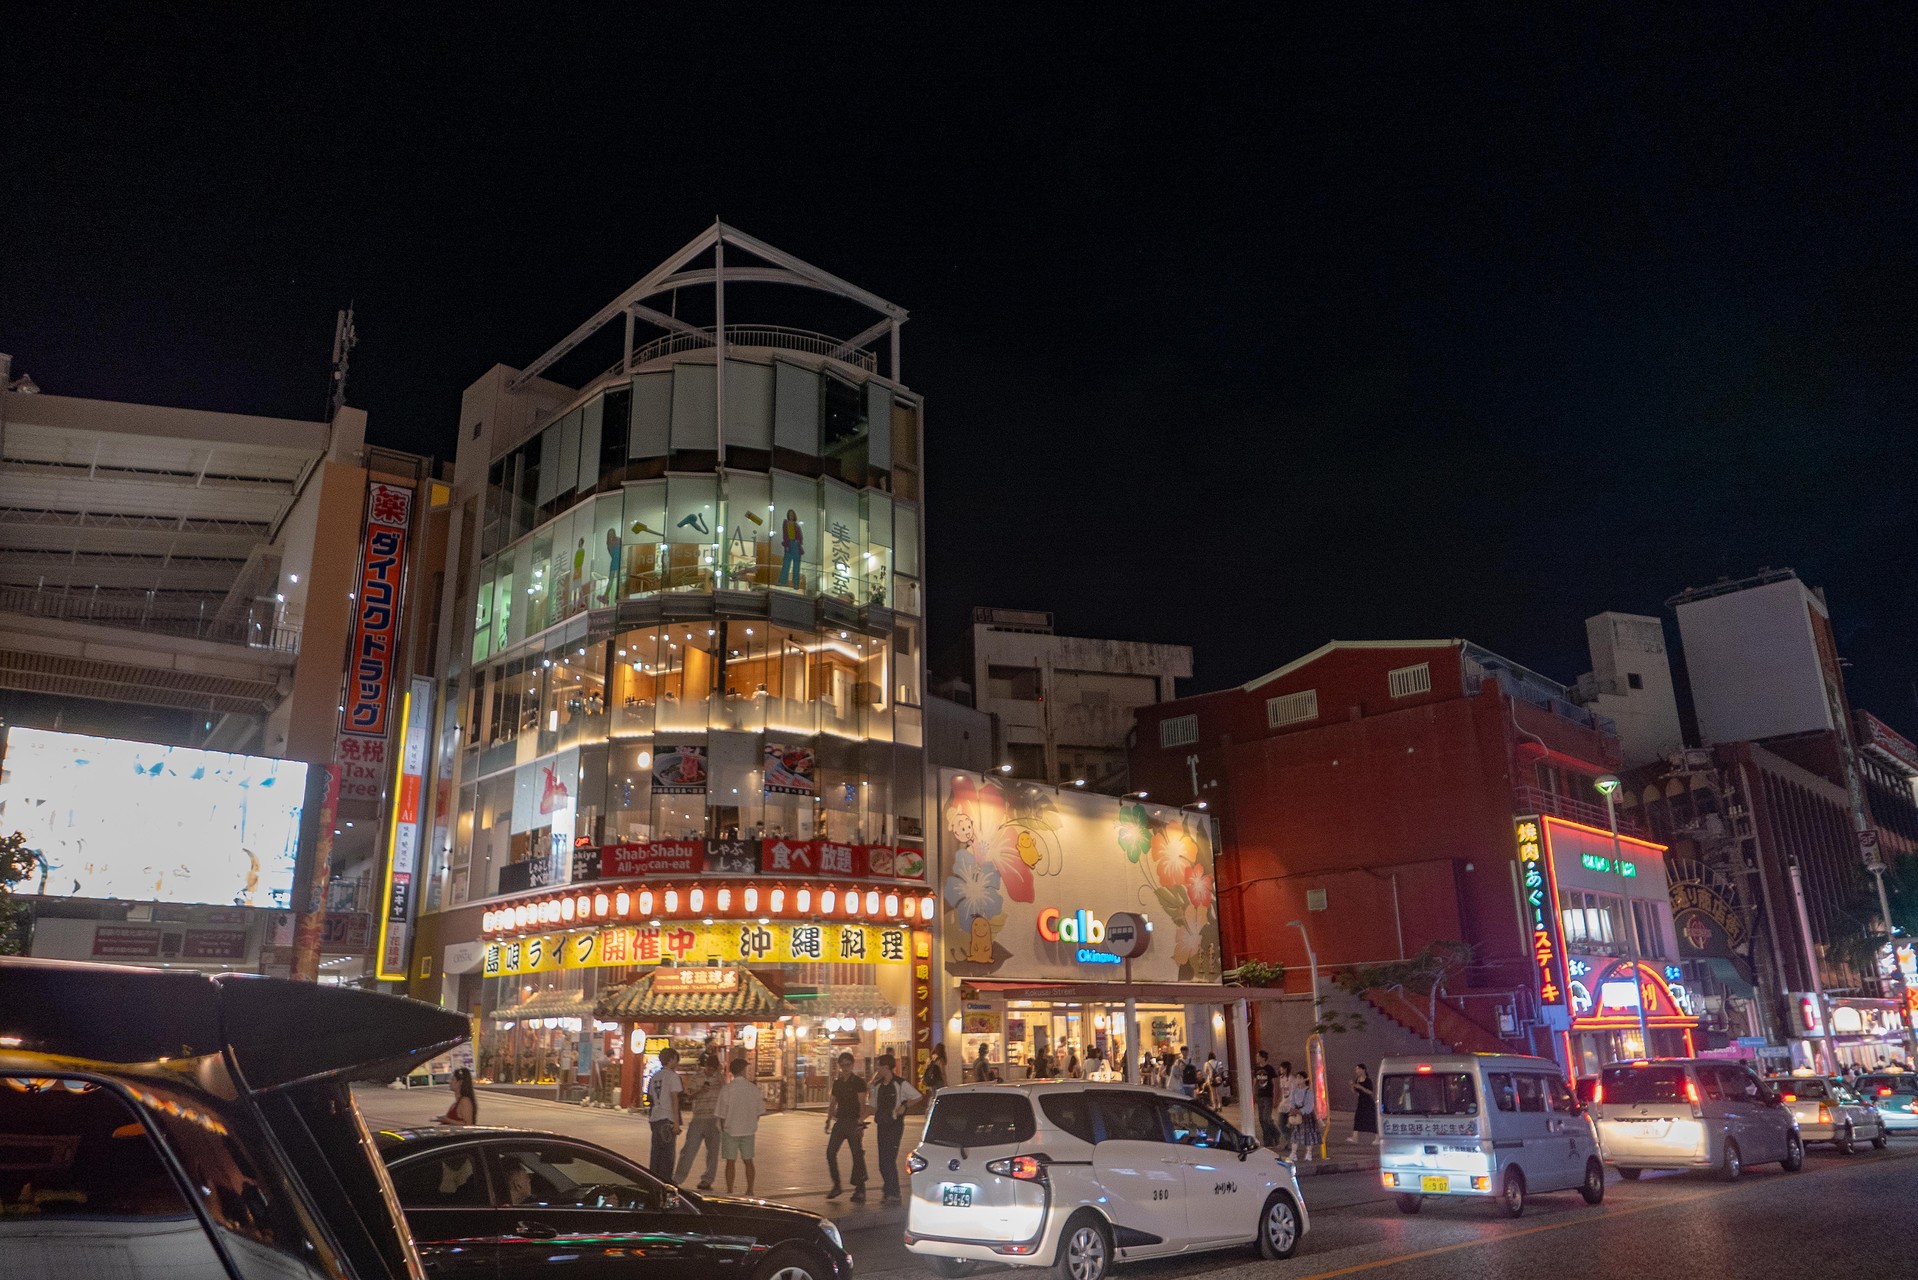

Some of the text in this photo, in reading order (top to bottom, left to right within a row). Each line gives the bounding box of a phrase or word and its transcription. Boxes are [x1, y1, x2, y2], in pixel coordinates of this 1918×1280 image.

[374, 485, 404, 521] 薬
[729, 525, 757, 557] Ai
[831, 522, 850, 595] 美容室
[354, 530, 401, 727] ダイコクドラッグ
[340, 737, 384, 762] 免税
[344, 762, 375, 778] Tax
[650, 844, 693, 857] Shabu
[707, 841, 744, 856] しゃぶ
[650, 859, 690, 870] can-eat
[720, 857, 756, 872] しゃぶ
[1037, 907, 1109, 944] Calb
[740, 926, 905, 960] 沖縄料理
[1153, 1189, 1169, 1200] 360
[1214, 1182, 1237, 1195] かりゆし
